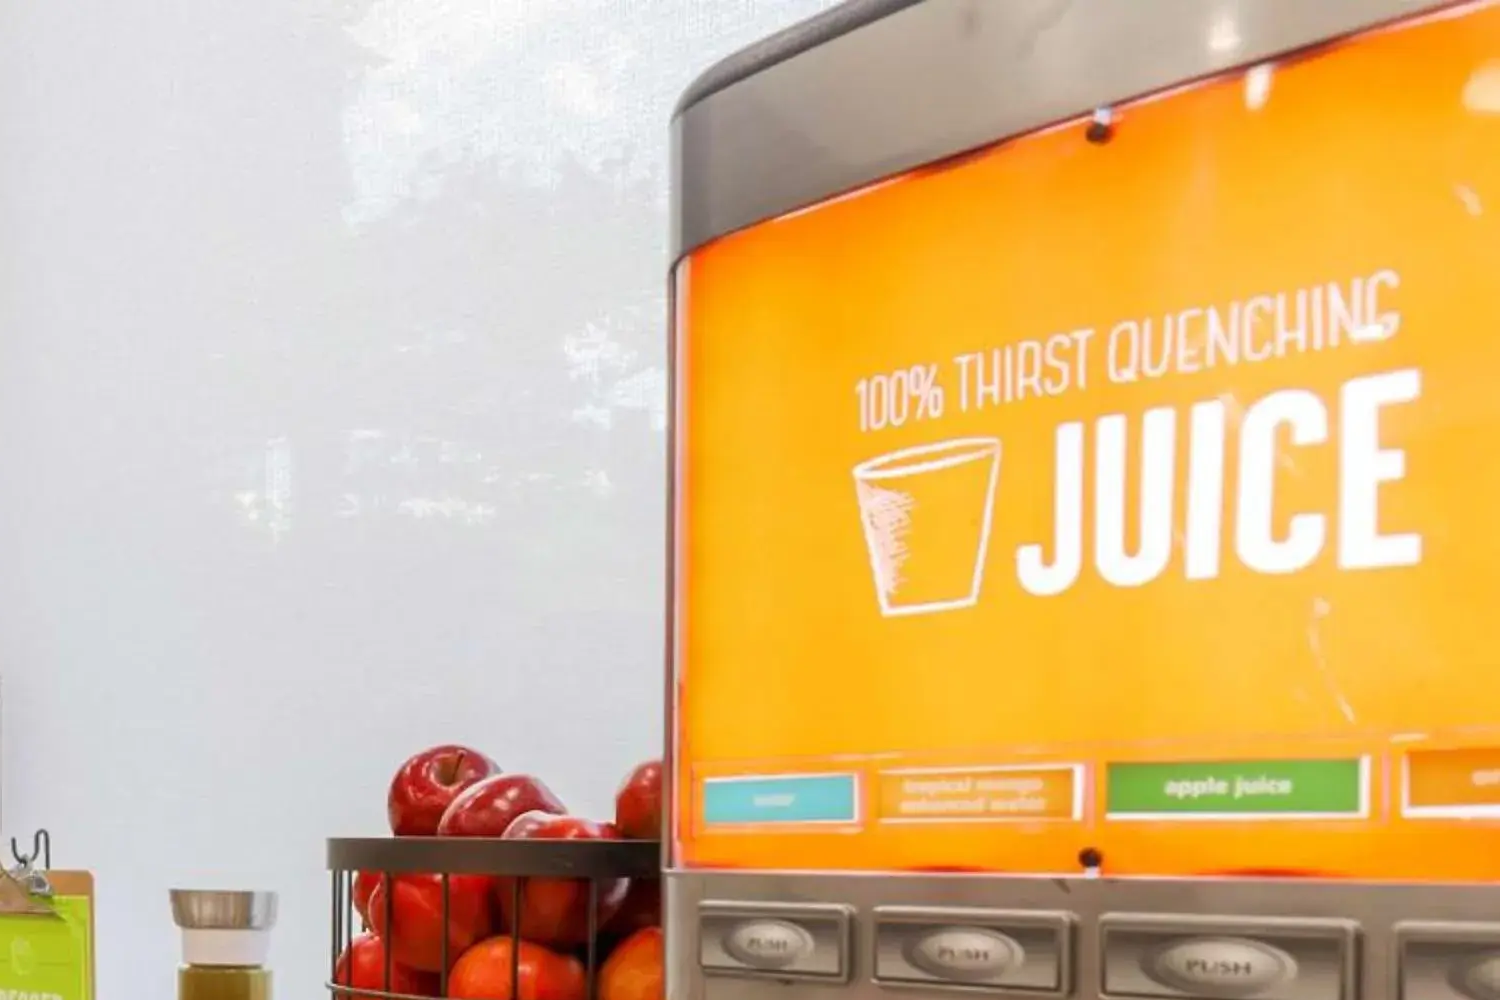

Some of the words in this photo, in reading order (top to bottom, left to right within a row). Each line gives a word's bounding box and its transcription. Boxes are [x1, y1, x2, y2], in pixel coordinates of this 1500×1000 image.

[856, 363, 944, 432] 100%
[954, 327, 1094, 413] THIRST
[1106, 270, 1401, 384] QUENCHING
[1016, 367, 1422, 596] JUICE
[1164, 777, 1229, 798] apple
[1233, 774, 1292, 799] juice
[937, 945, 990, 962] PUSH
[1185, 958, 1252, 977] PUSH
